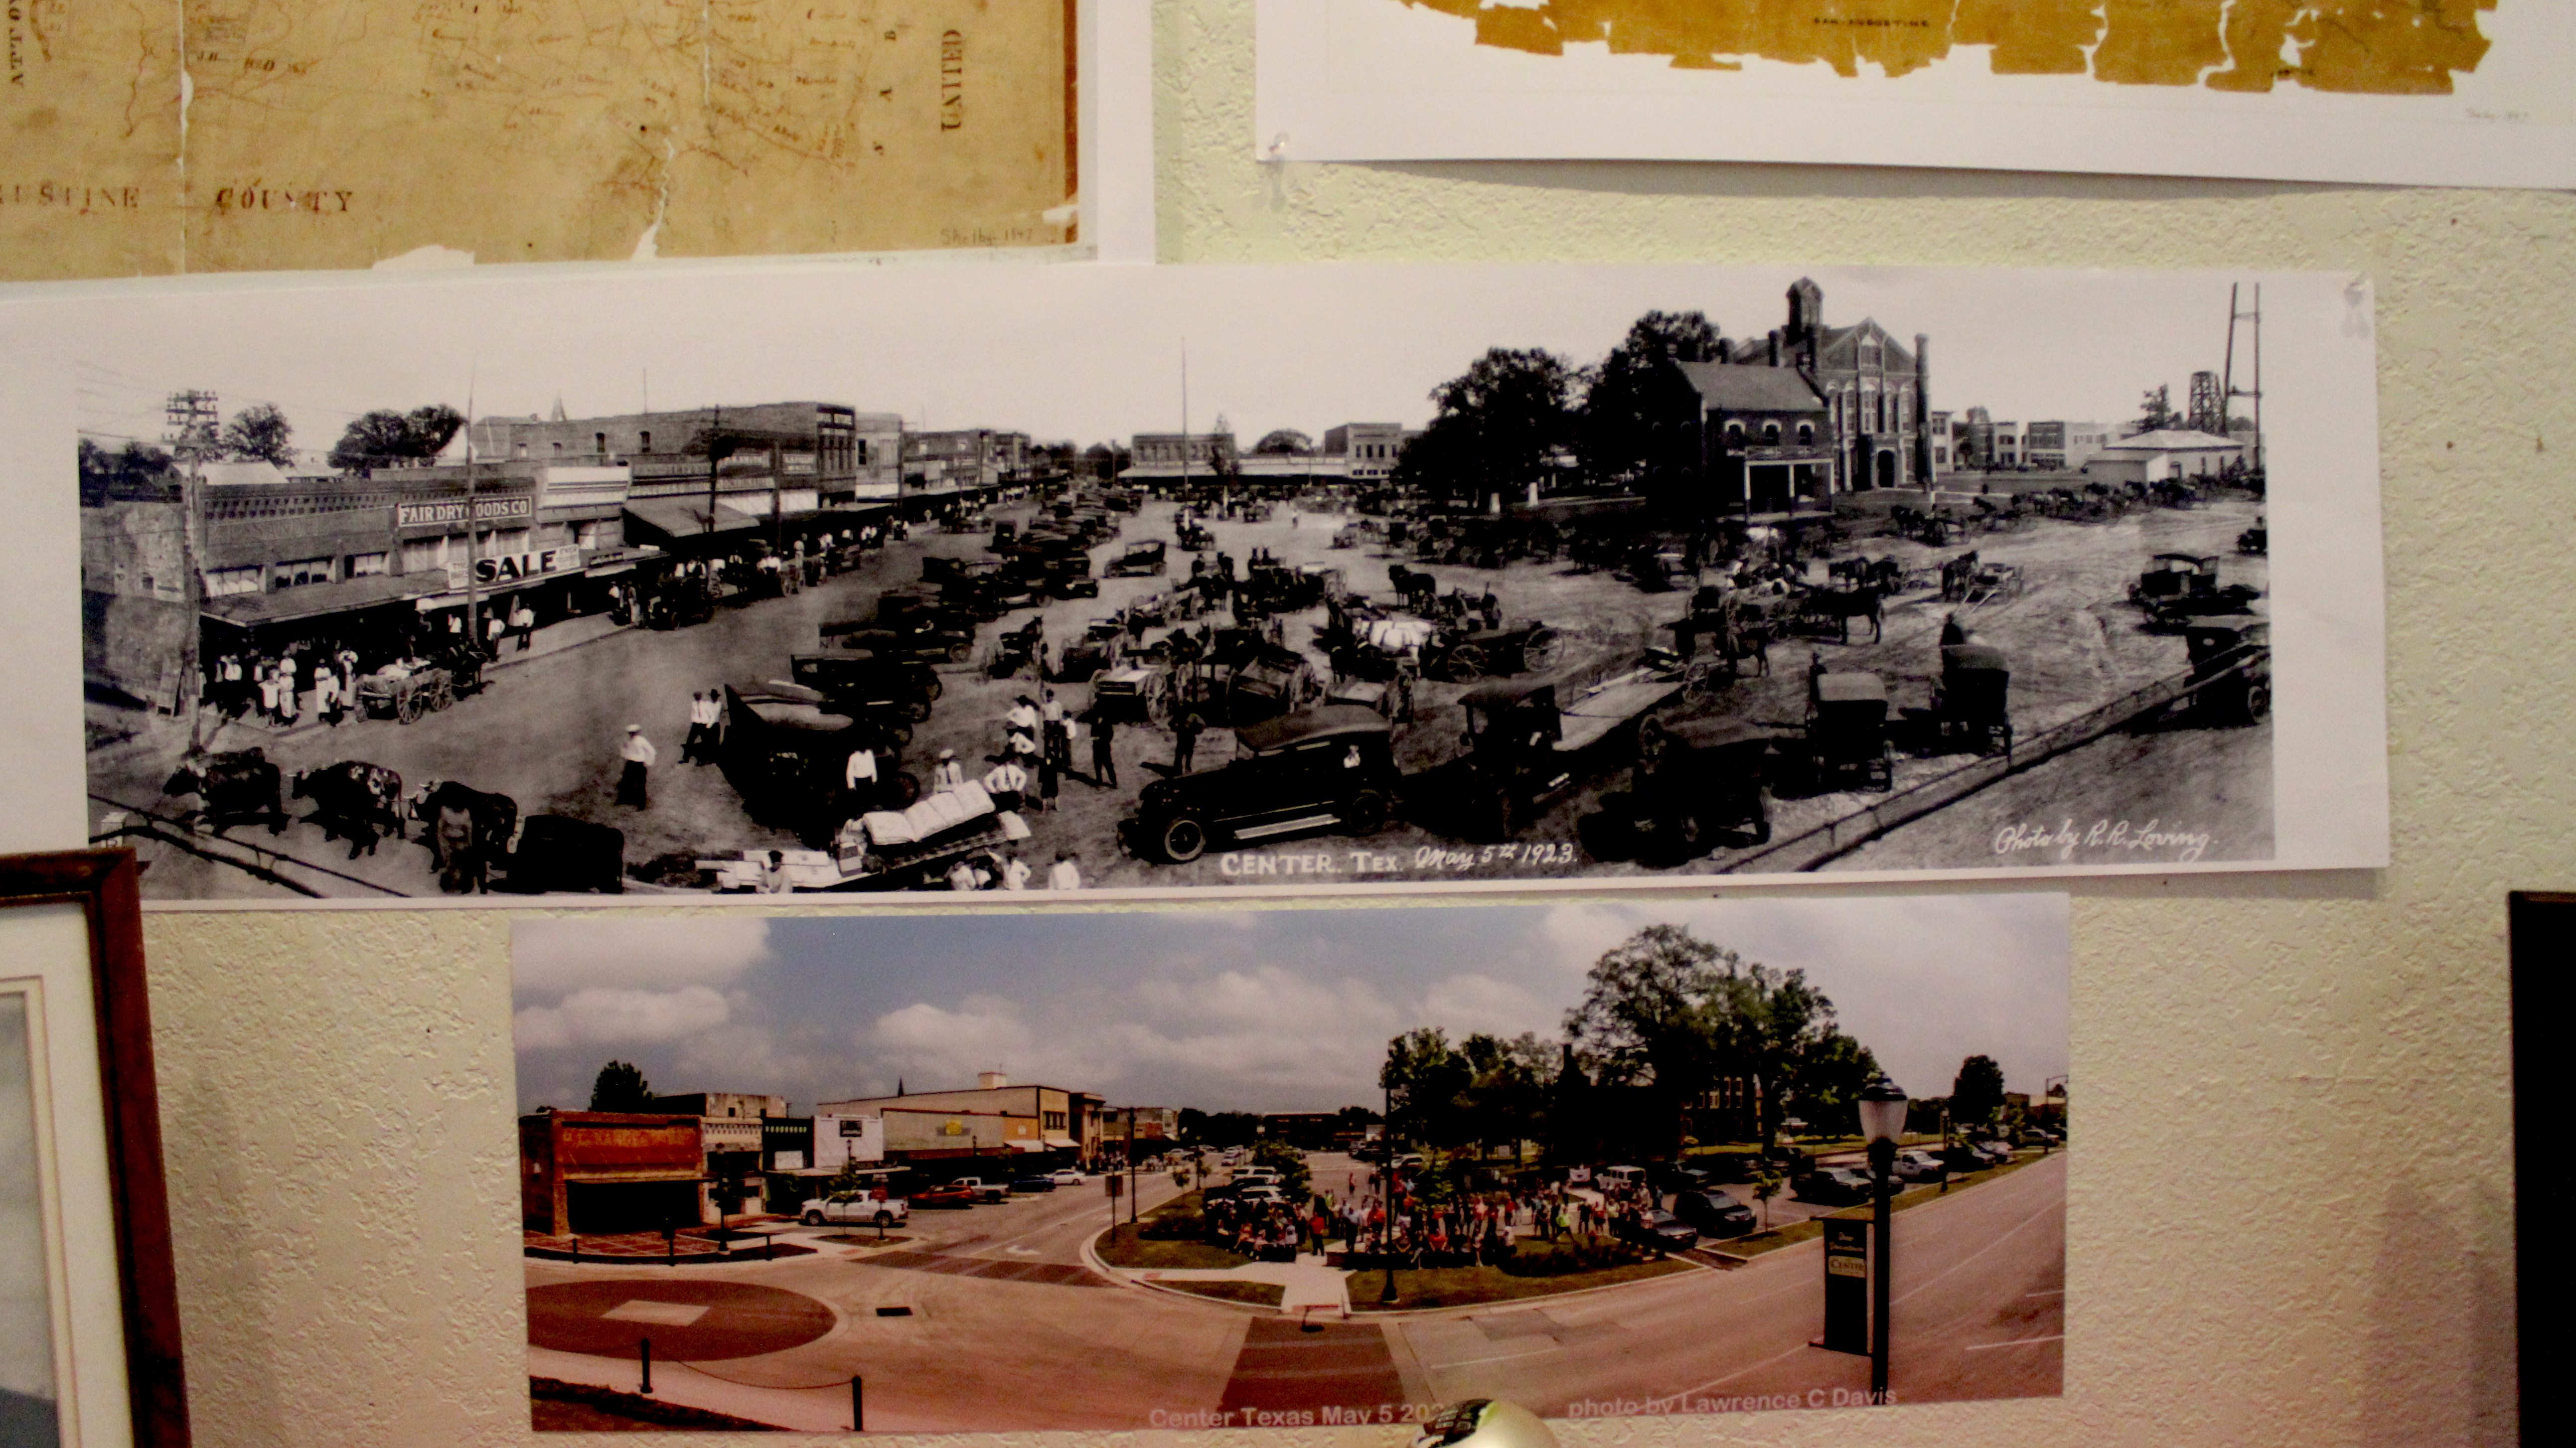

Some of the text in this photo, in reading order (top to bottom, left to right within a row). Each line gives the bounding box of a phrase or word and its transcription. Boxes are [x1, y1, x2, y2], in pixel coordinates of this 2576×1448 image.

[941, 29, 962, 132] UNITED
[215, 187, 352, 212] COUNTY
[398, 506, 435, 523] FAIR
[437, 504, 463, 520] DRY
[511, 500, 527, 514] CO
[475, 550, 556, 582] SALE
[1995, 823, 2054, 854] Photo
[2055, 818, 2080, 860] by
[1415, 845, 1476, 870] May
[1150, 1408, 1234, 1428] Center
[1240, 1407, 1314, 1426] Texas
[1322, 1405, 1371, 1426] May
[1378, 1404, 1393, 1423] 5
[1568, 1387, 1897, 1418] photo by Lawrence C Davis
